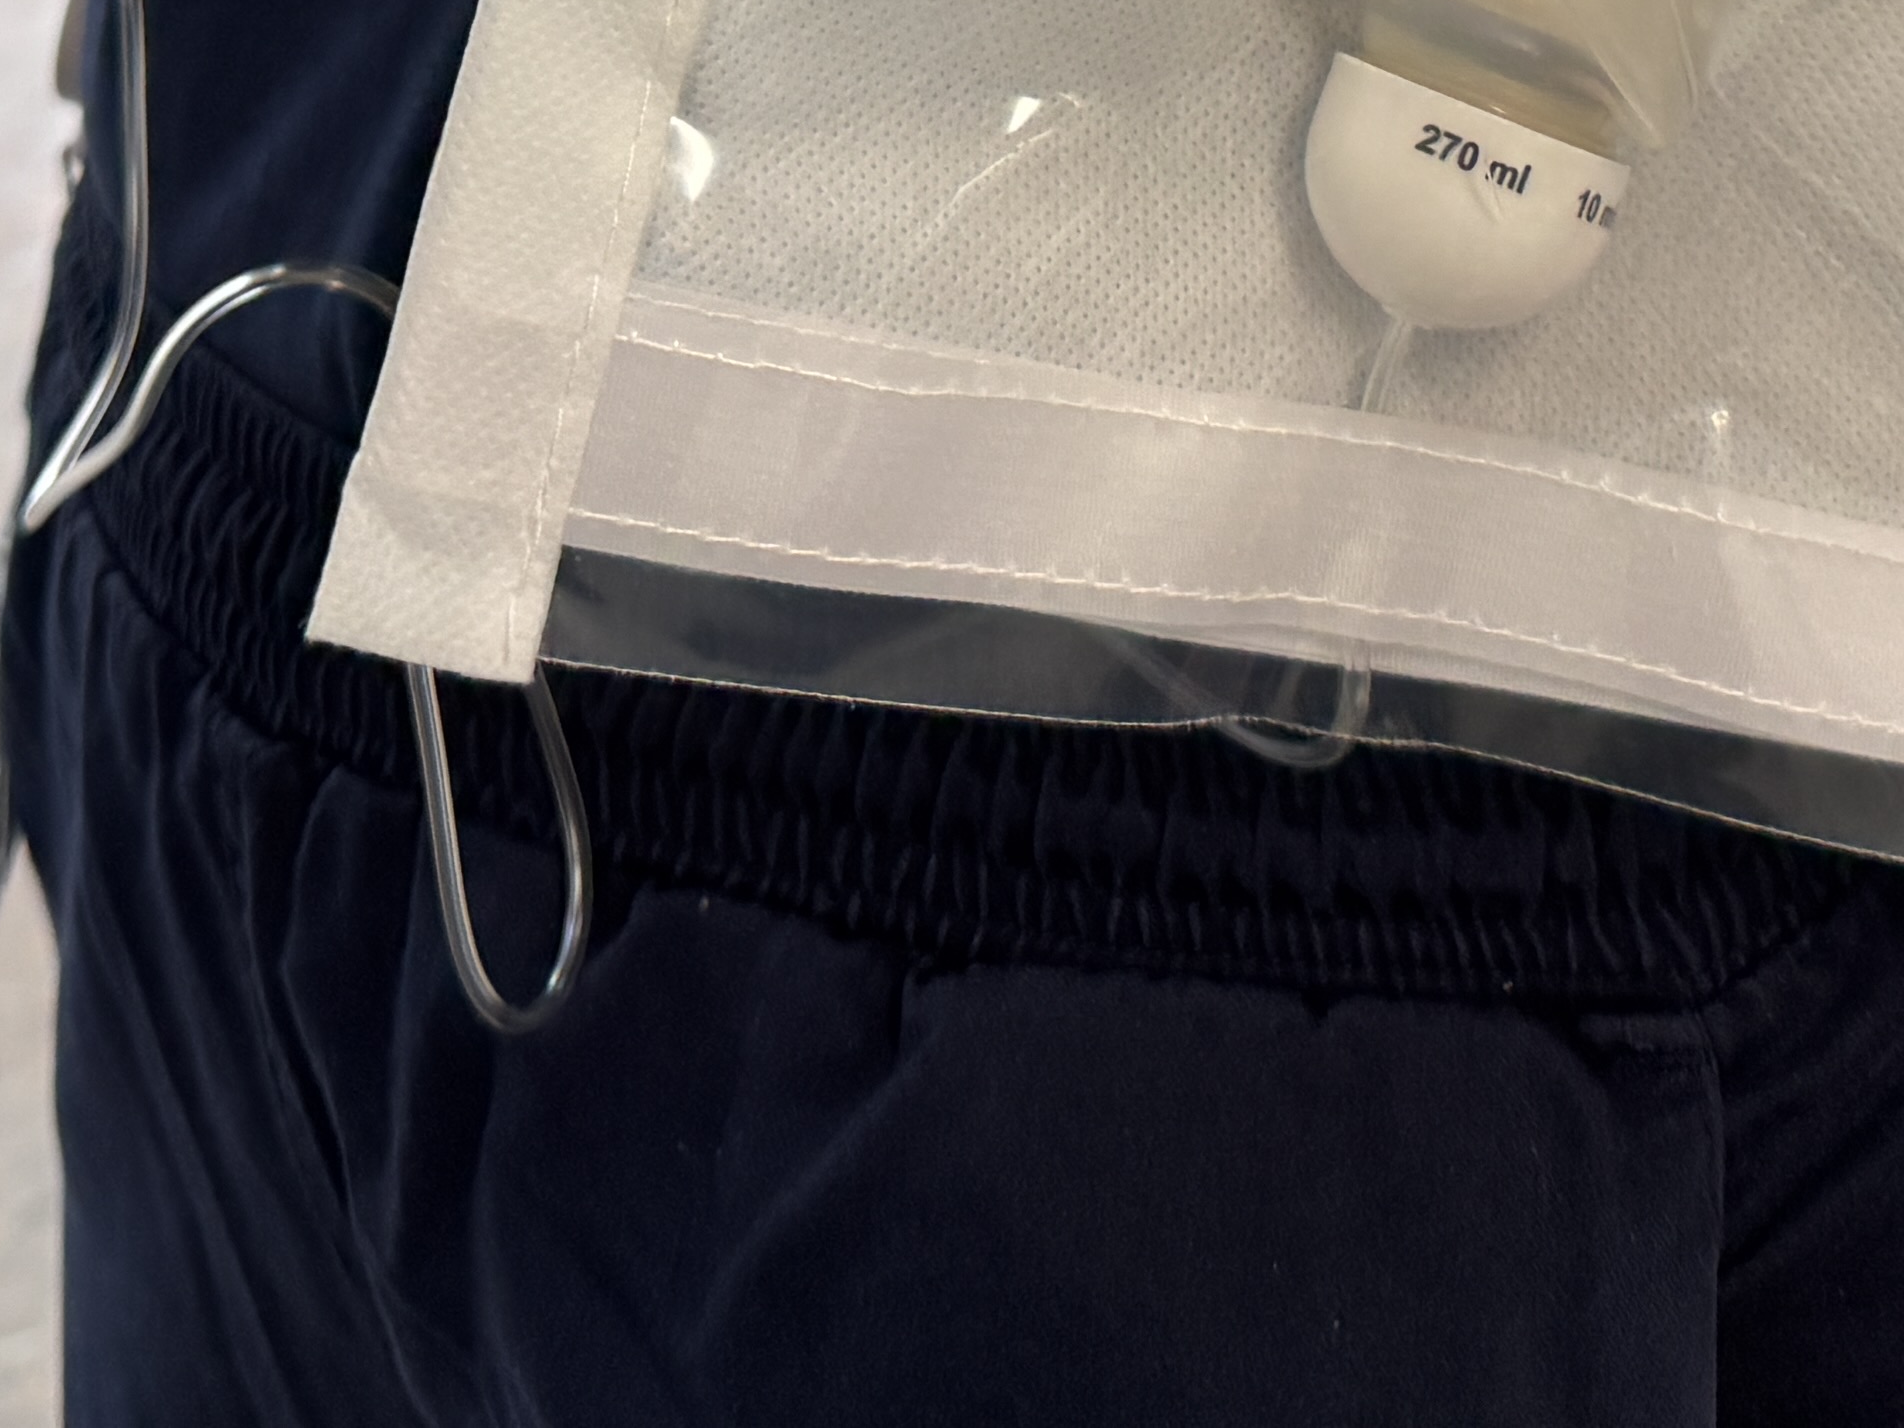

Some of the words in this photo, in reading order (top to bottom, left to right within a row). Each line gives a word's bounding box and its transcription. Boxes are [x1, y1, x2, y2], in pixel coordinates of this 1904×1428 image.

[1414, 124, 1480, 172] 270
[1485, 160, 1532, 194] ml
[1577, 189, 1602, 223] 10
